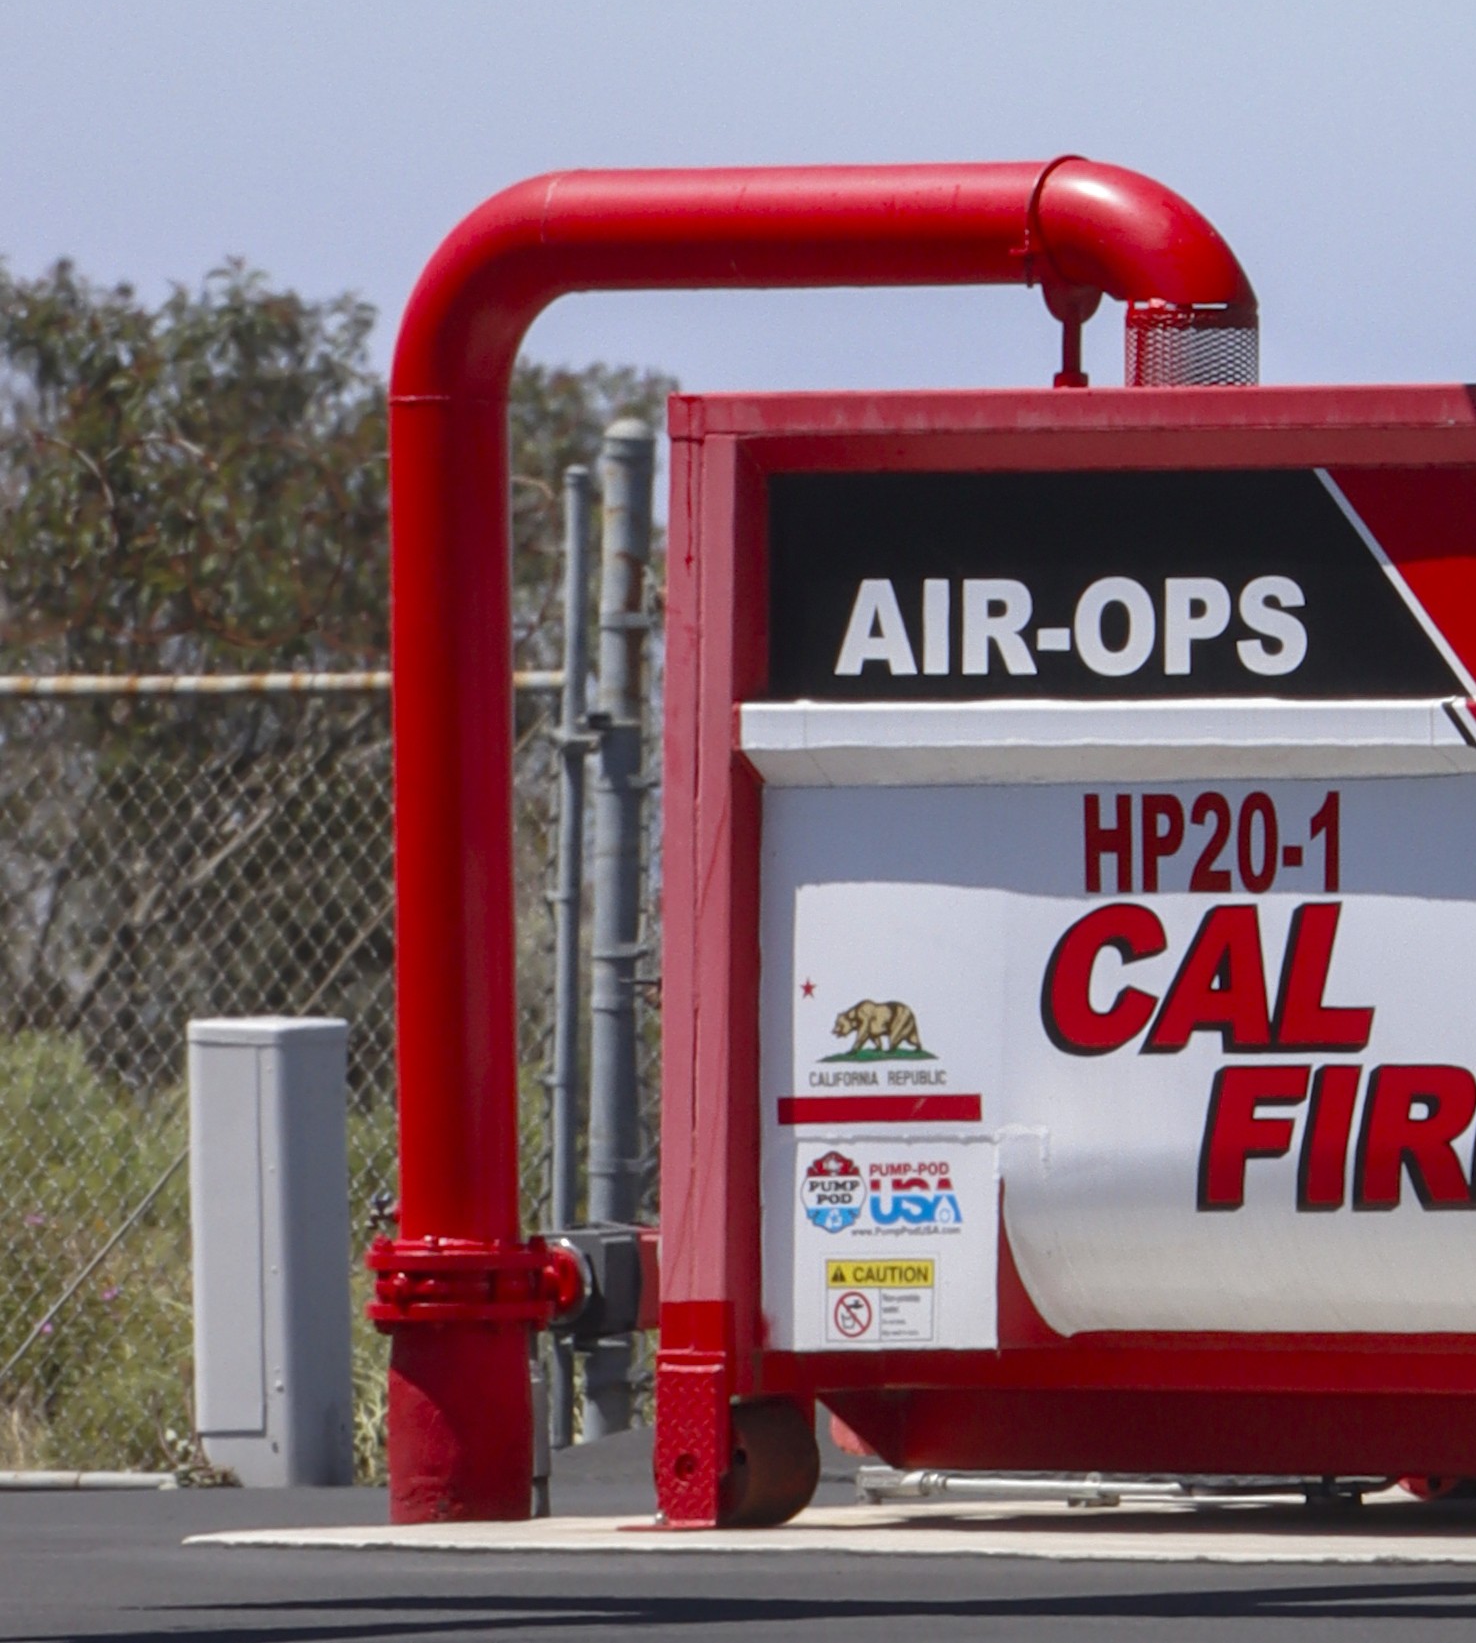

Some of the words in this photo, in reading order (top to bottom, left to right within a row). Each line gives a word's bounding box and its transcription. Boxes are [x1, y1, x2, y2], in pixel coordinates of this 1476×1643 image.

[833, 575, 1308, 677] AIR-OPS
[1083, 790, 1341, 894] HP20-1
[1040, 901, 1376, 1057] CAL
[809, 1071, 879, 1087] CALIFORNIA
[887, 1070, 948, 1086] REPUBLIC
[869, 1162, 950, 1177] PUMP-POD
[808, 1180, 861, 1193] PUMP
[816, 1193, 853, 1205] POD
[869, 1177, 963, 1225] USA
[852, 1266, 929, 1283] CAUTION
